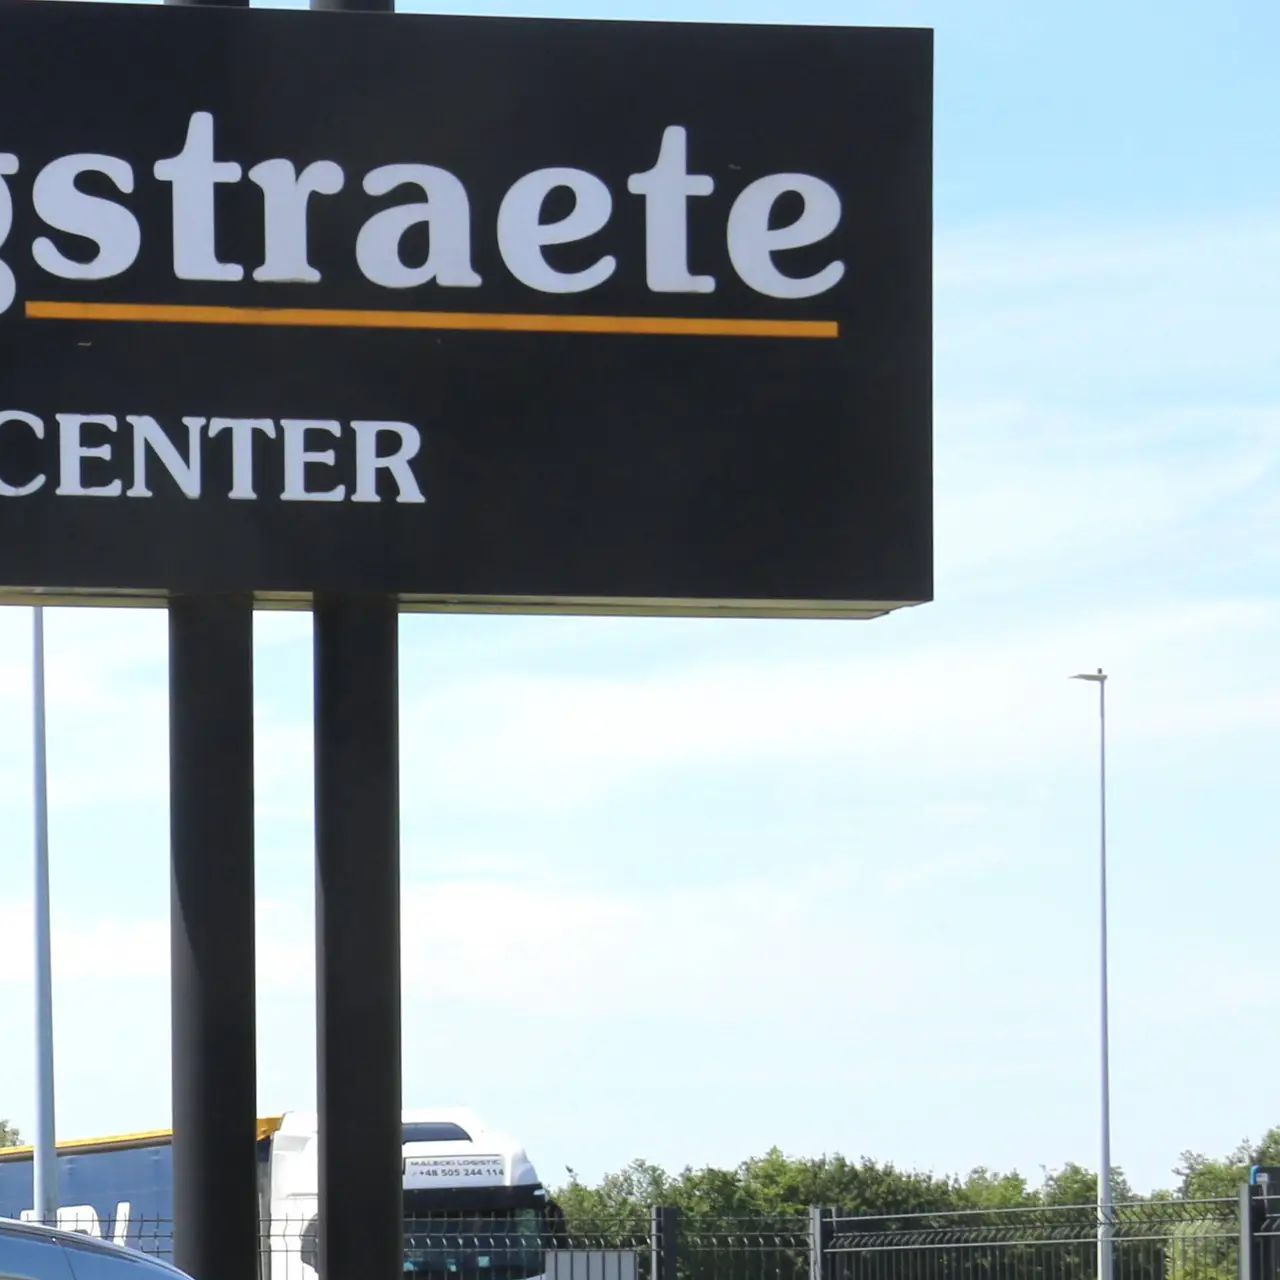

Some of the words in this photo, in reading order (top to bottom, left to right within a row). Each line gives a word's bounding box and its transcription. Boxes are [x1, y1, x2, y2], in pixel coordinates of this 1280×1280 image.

[441, 1168, 461, 1177] 505
[463, 1168, 482, 1176] 244
[486, 1168, 505, 1176] 114
